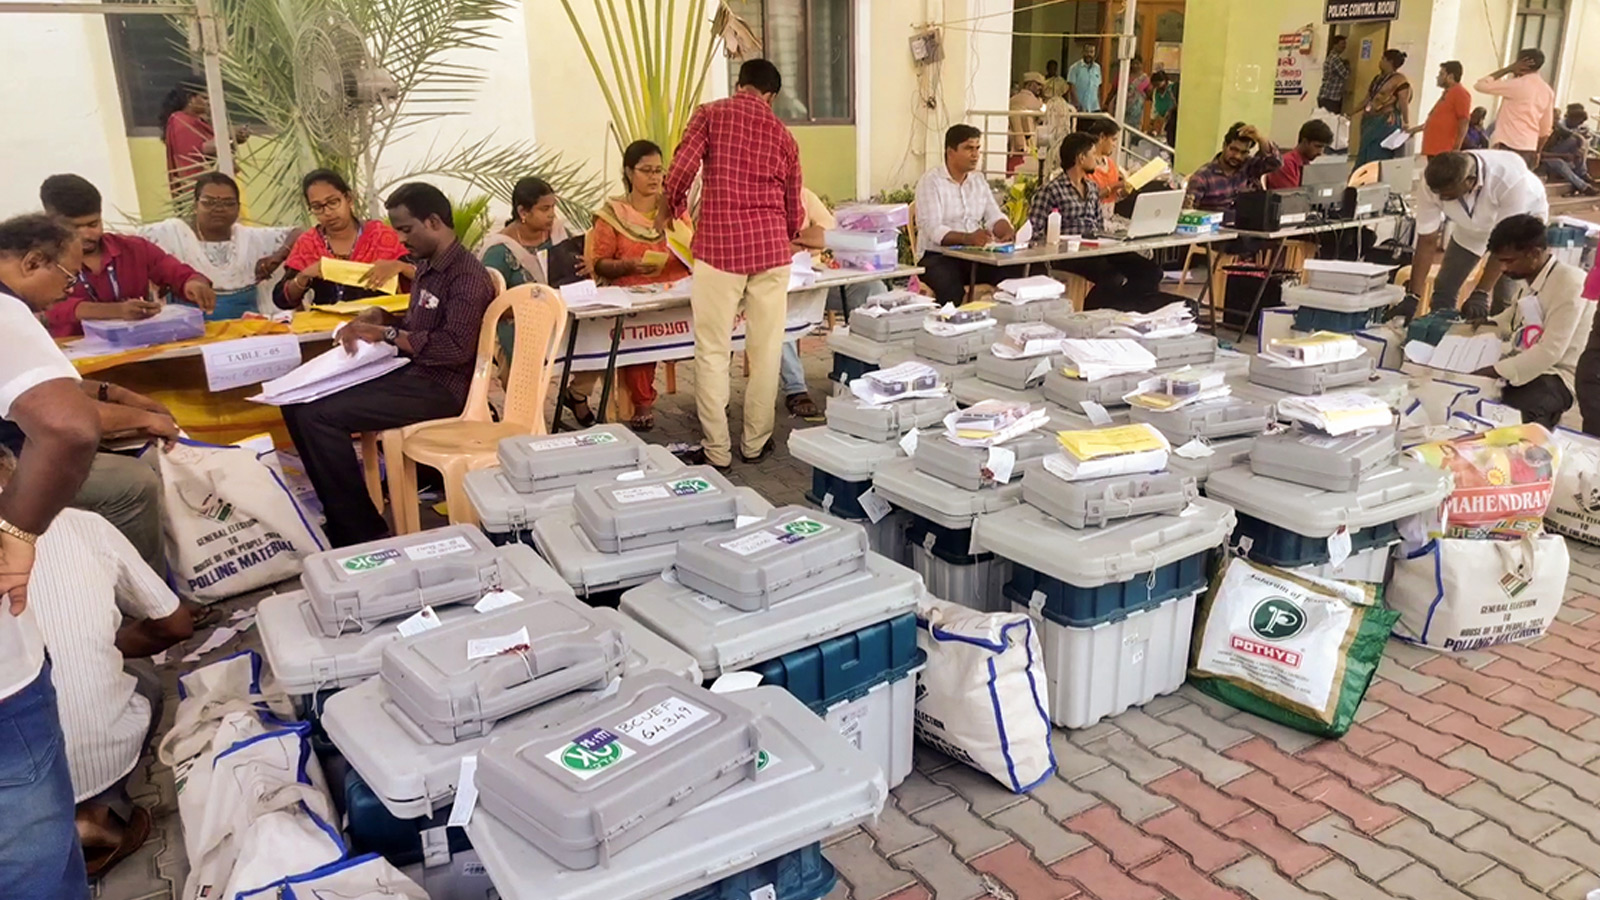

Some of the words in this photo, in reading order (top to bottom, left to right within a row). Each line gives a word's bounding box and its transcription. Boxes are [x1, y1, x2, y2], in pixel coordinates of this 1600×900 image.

[1327, 4, 1348, 18] POLICE
[1348, 2, 1377, 16] CONTROL
[1376, 1, 1397, 15] ROOM
[227, 350, 261, 363] TABLE
[268, 347, 281, 356] 05
[196, 529, 228, 546] GENERAL
[227, 518, 259, 534] ELECTION
[228, 535, 239, 546] TO
[213, 554, 223, 564] OF
[224, 547, 236, 558] THE
[187, 561, 238, 592] POLLING
[237, 541, 297, 570] MATERIAL
[1481, 603, 1508, 614] GENERAL
[1509, 599, 1537, 611] ELECTION
[1503, 613, 1512, 622] TO
[1460, 627, 1482, 637] HOUSE
[1482, 626, 1491, 636] OF
[1491, 624, 1506, 635] THE
[1233, 637, 1298, 666] POTHYS
[1444, 636, 1494, 651] POLLING
[641, 705, 693, 740] 64349
